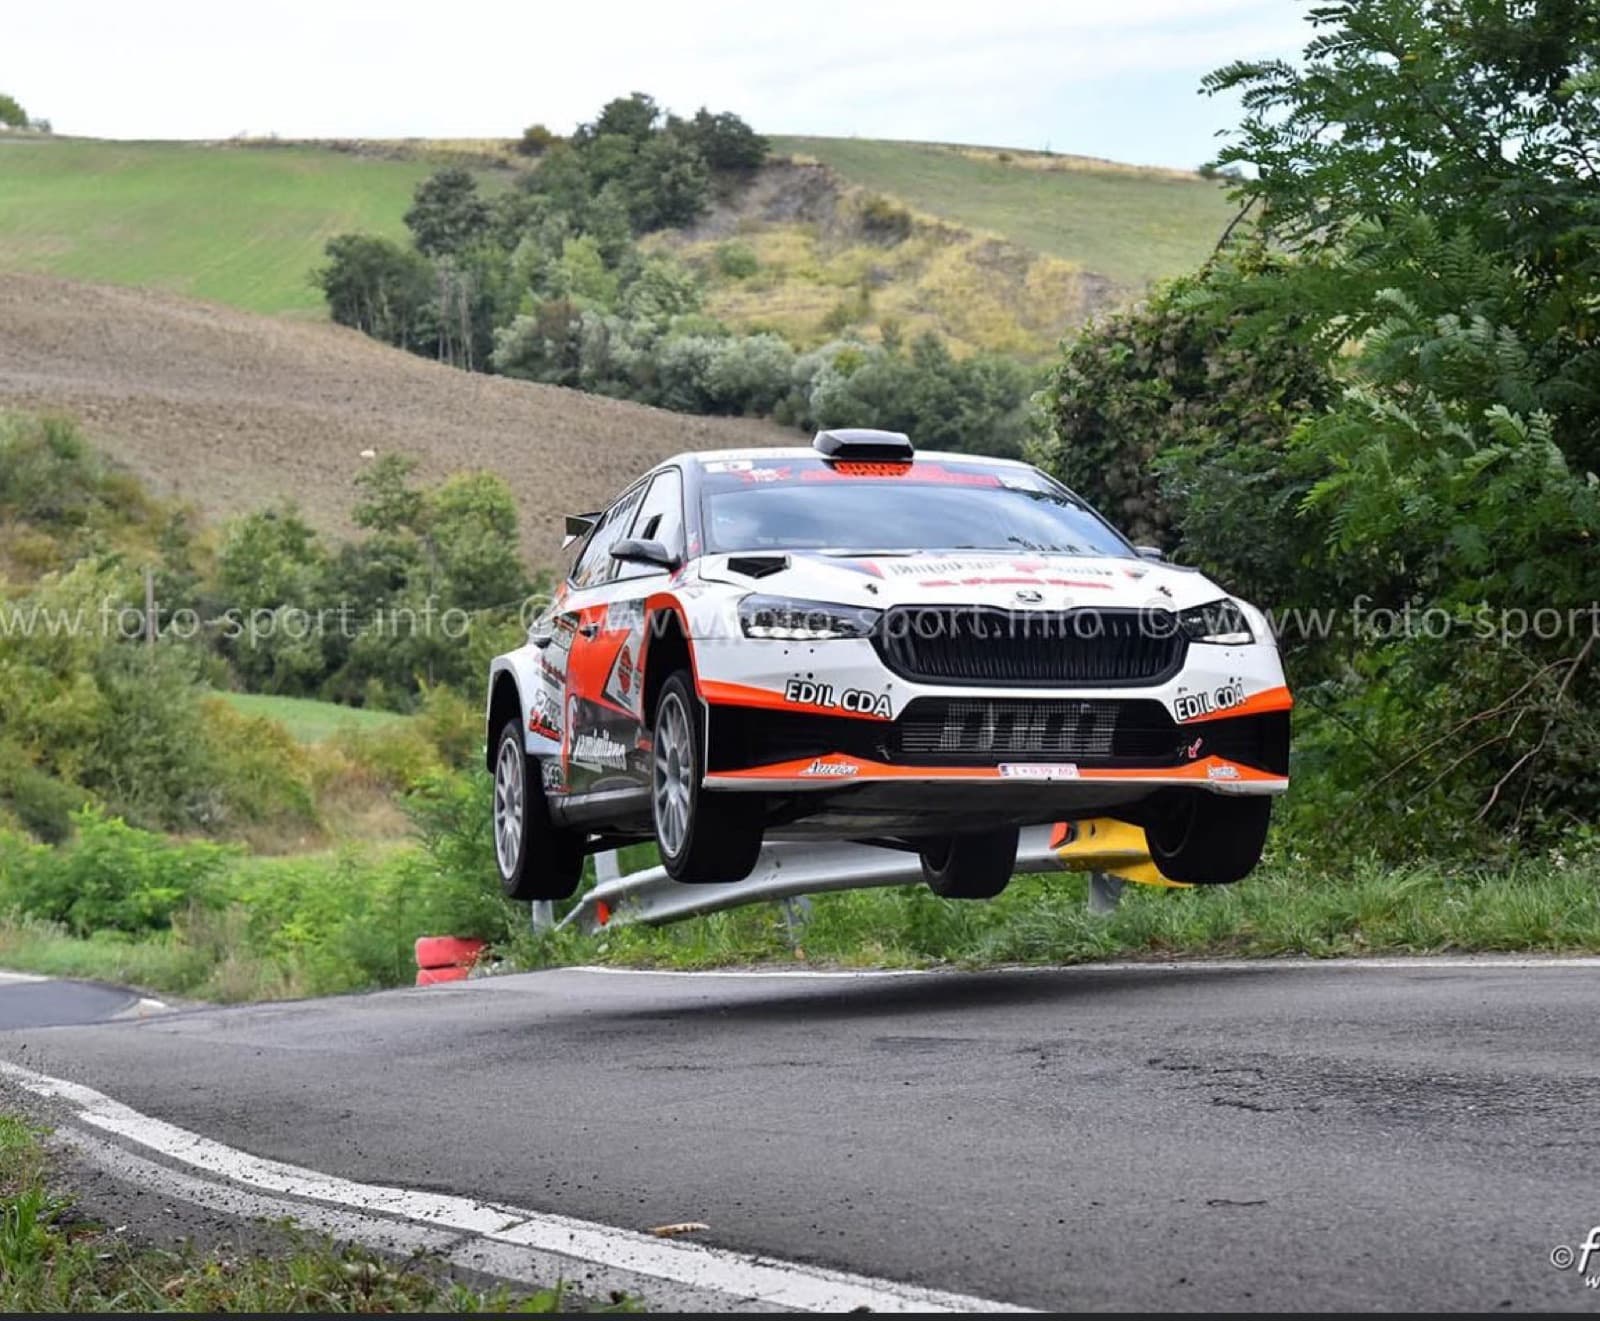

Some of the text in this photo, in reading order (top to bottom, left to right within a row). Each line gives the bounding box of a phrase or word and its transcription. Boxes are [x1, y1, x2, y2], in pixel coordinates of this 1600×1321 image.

[785, 680, 892, 719] EDIL CDA
[1174, 683, 1245, 721] EDIL CDA
